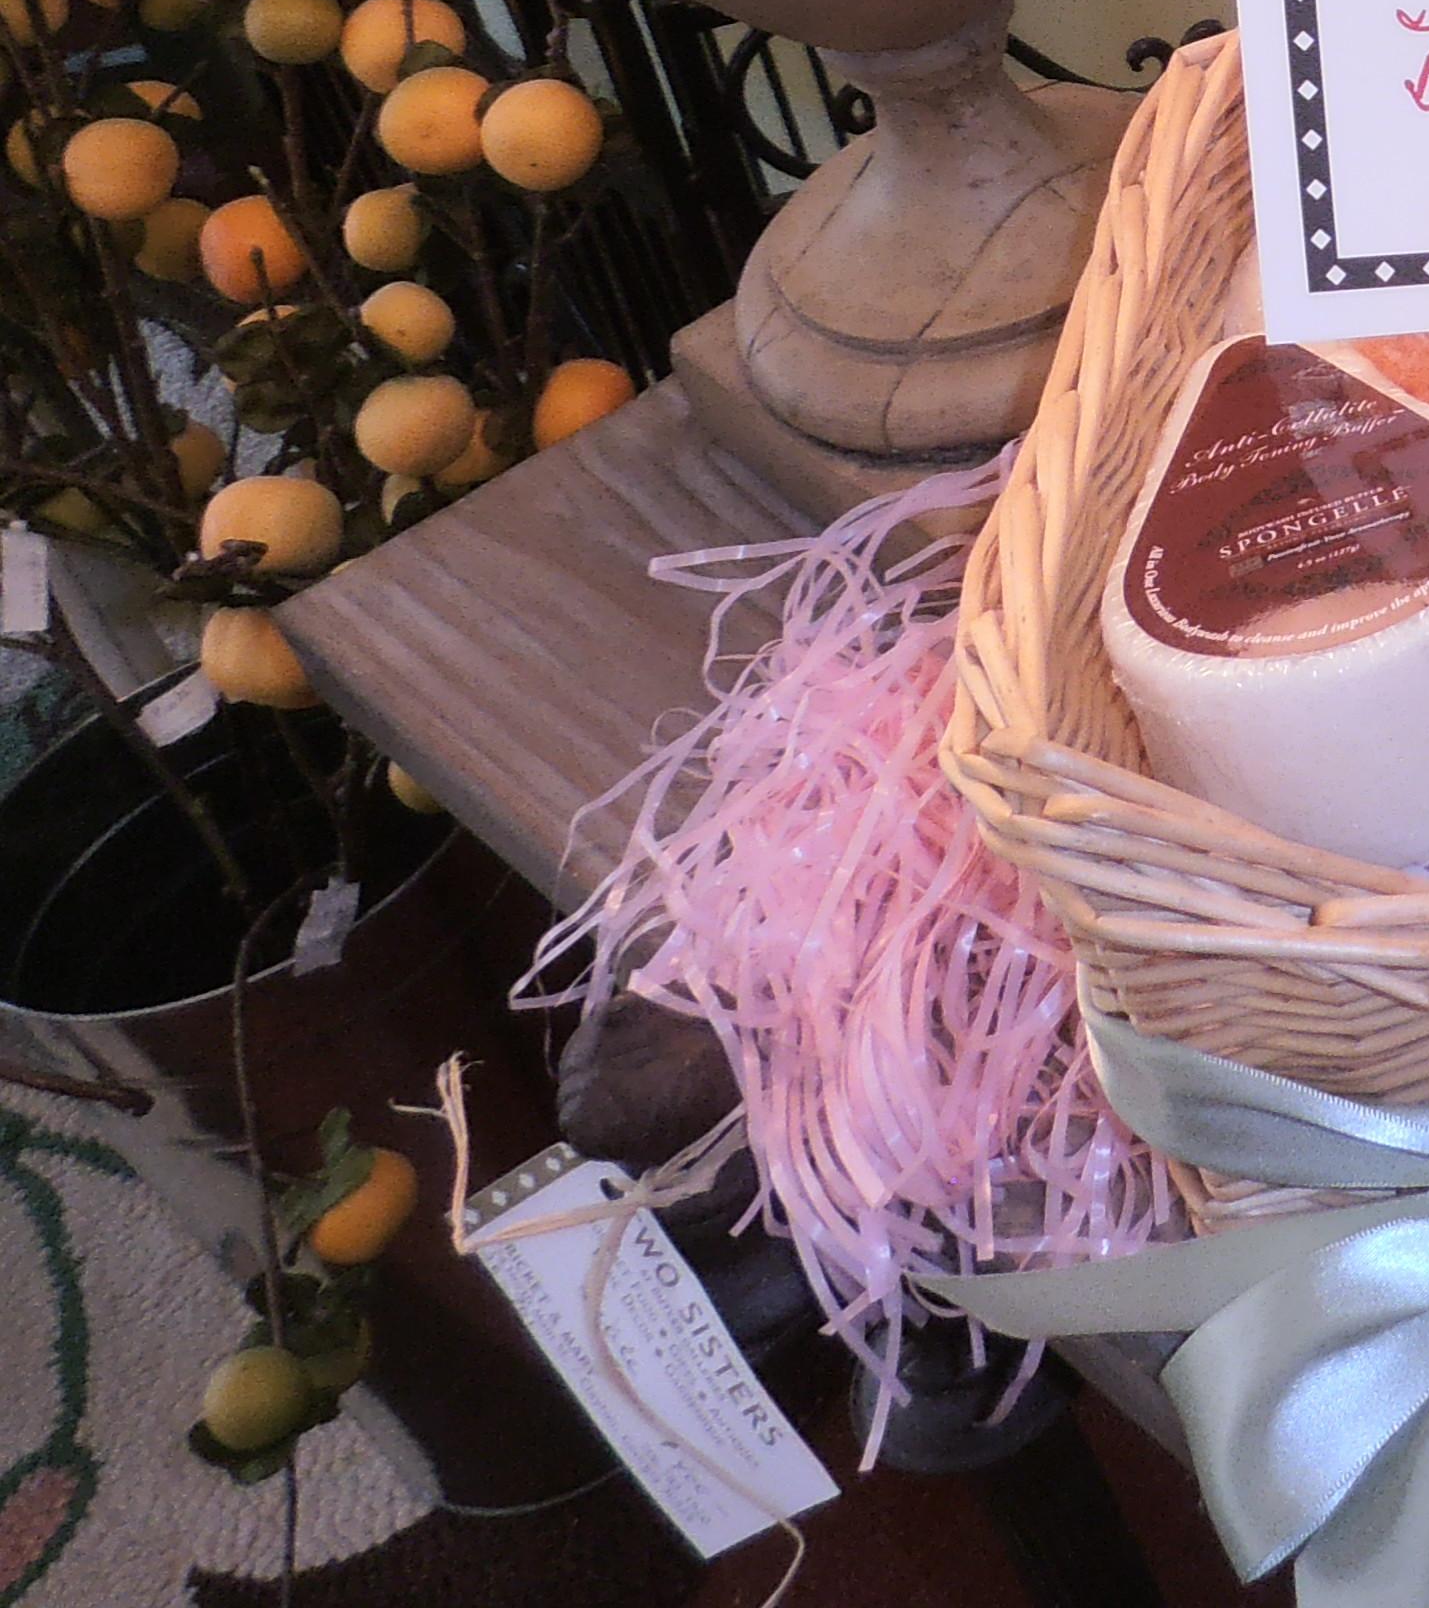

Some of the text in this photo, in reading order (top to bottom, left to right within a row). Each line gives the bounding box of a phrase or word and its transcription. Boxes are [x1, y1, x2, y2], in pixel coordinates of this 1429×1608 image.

[1168, 462, 1237, 495] Body
[1238, 435, 1318, 472] Toning
[1184, 399, 1378, 468] Anti-Cellulite
[1331, 606, 1388, 635] improve
[1390, 596, 1411, 610] the
[633, 1212, 784, 1448] WO SISTERS
